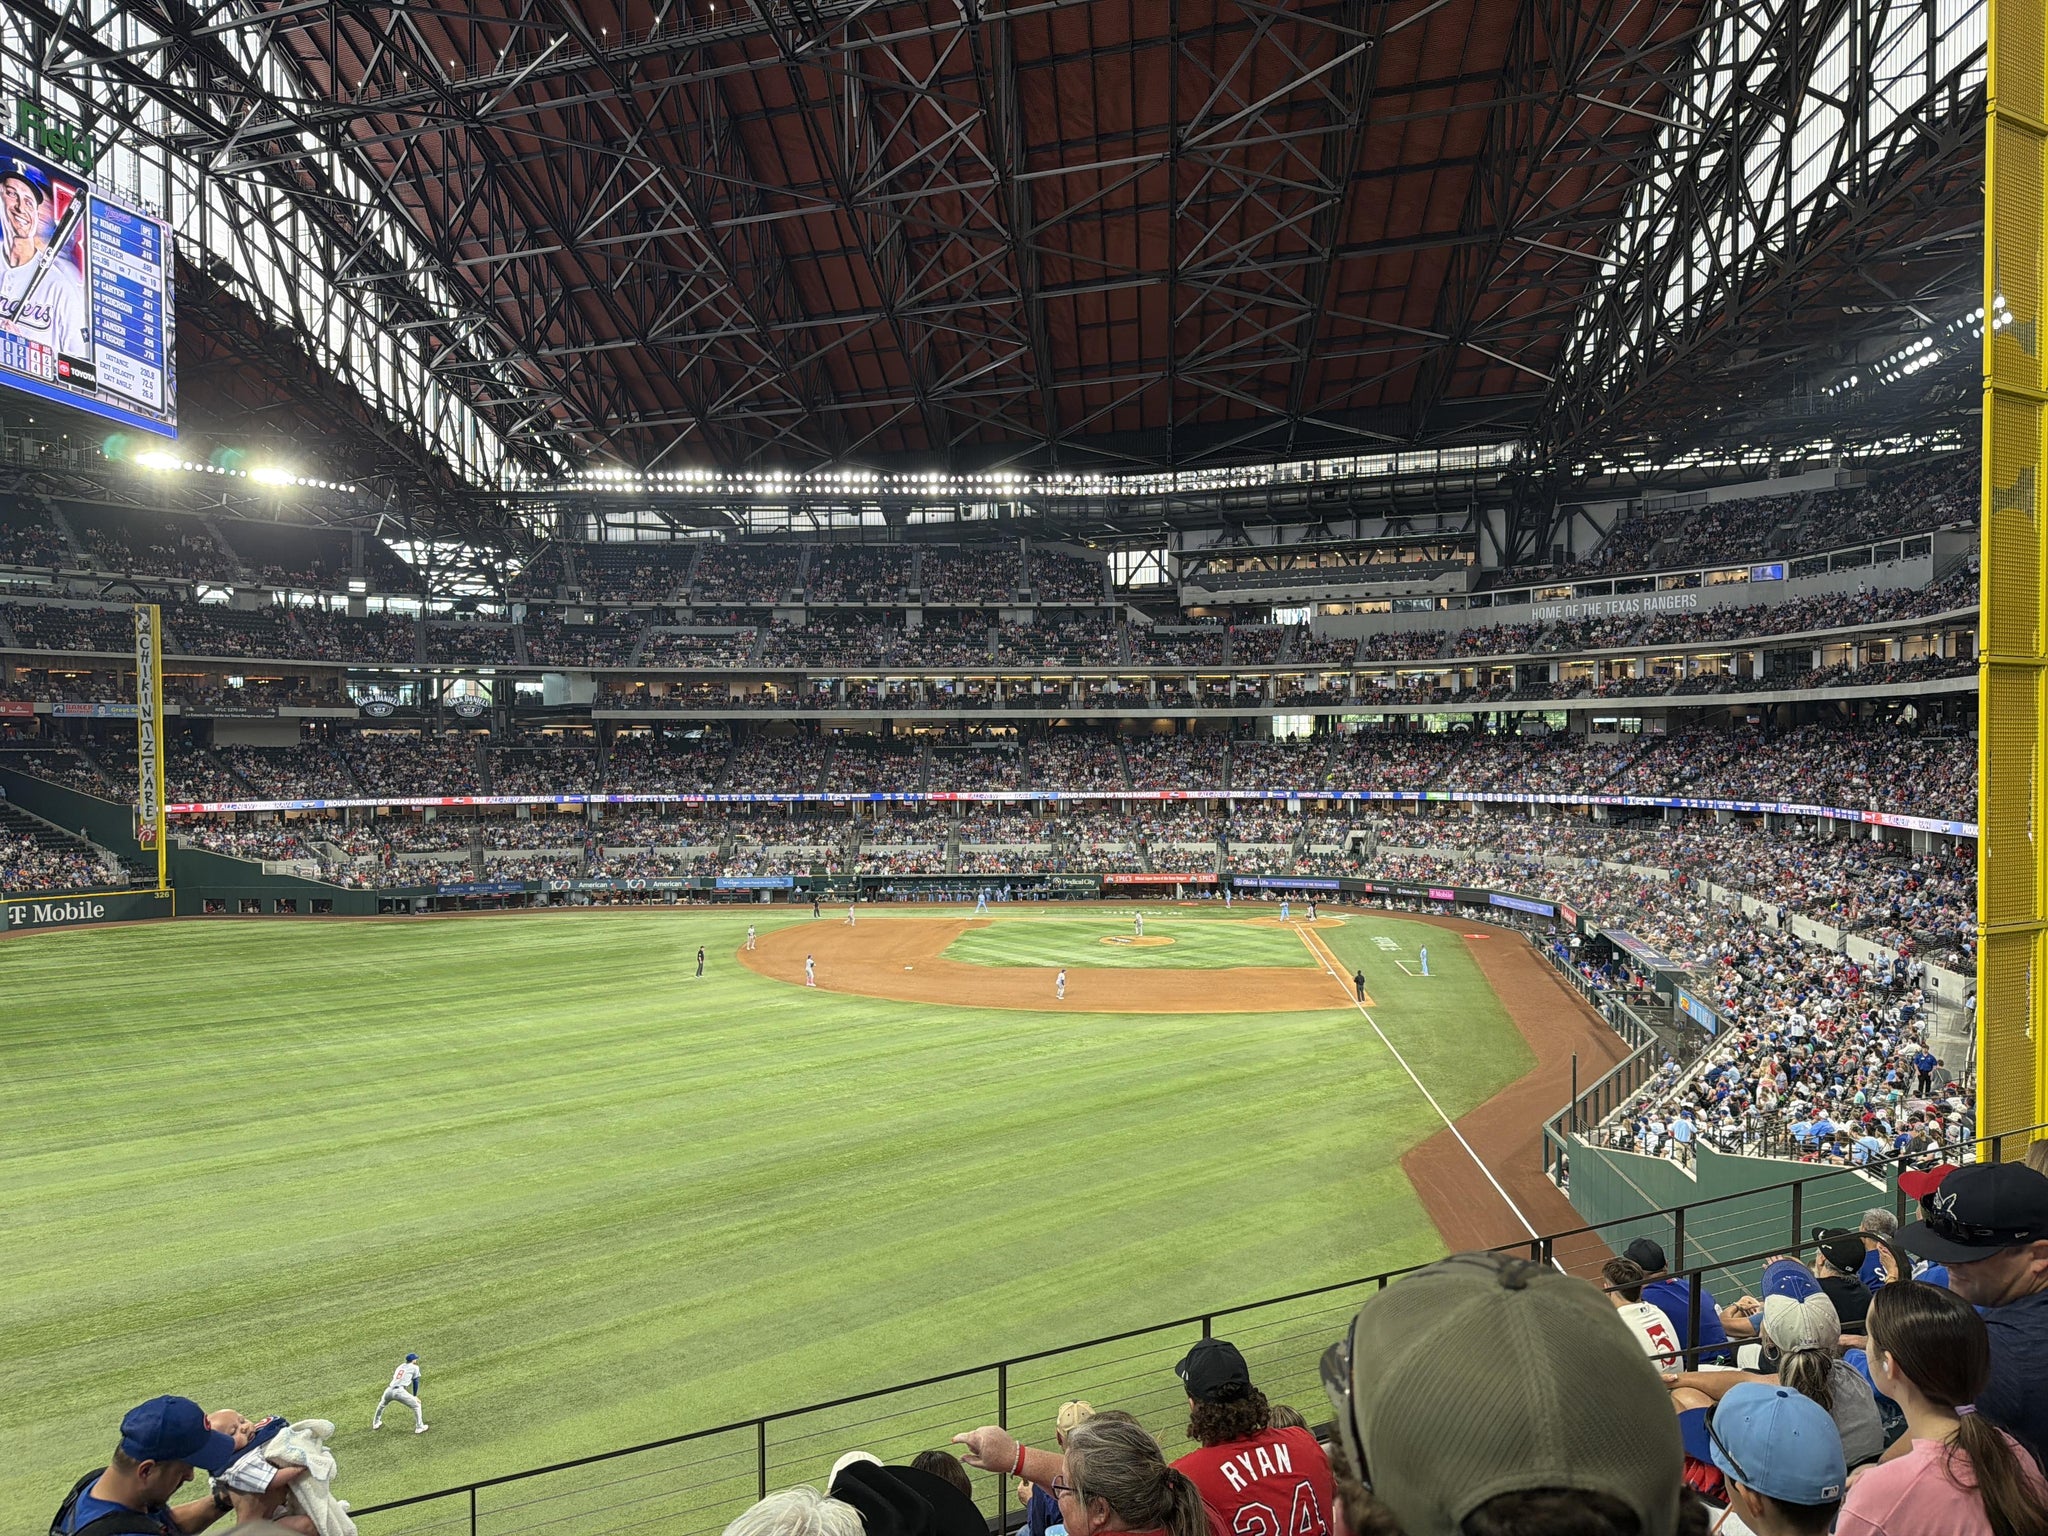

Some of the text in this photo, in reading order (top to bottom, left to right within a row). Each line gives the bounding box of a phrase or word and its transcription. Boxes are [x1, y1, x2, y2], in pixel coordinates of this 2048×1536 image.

[20, 99, 94, 170] Field
[100, 244, 124, 260] SEAGER
[105, 354, 129, 368] DISTANCE
[71, 368, 96, 382] TOYOTA
[100, 361, 135, 381] EXIT VELOCITY
[104, 373, 132, 390] EXIT ANGLE
[1532, 594, 1697, 620] HOME OF THE TEXAS RANGERS
[358, 694, 374, 706] JACK
[448, 694, 464, 706] JACK
[143, 726, 153, 752] IZ
[144, 762, 154, 817] FARE
[1436, 890, 1453, 898] Mobile
[32, 901, 105, 923] Mobile
[396, 1370, 404, 1380] 8
[1220, 1443, 1292, 1492] RYAN
